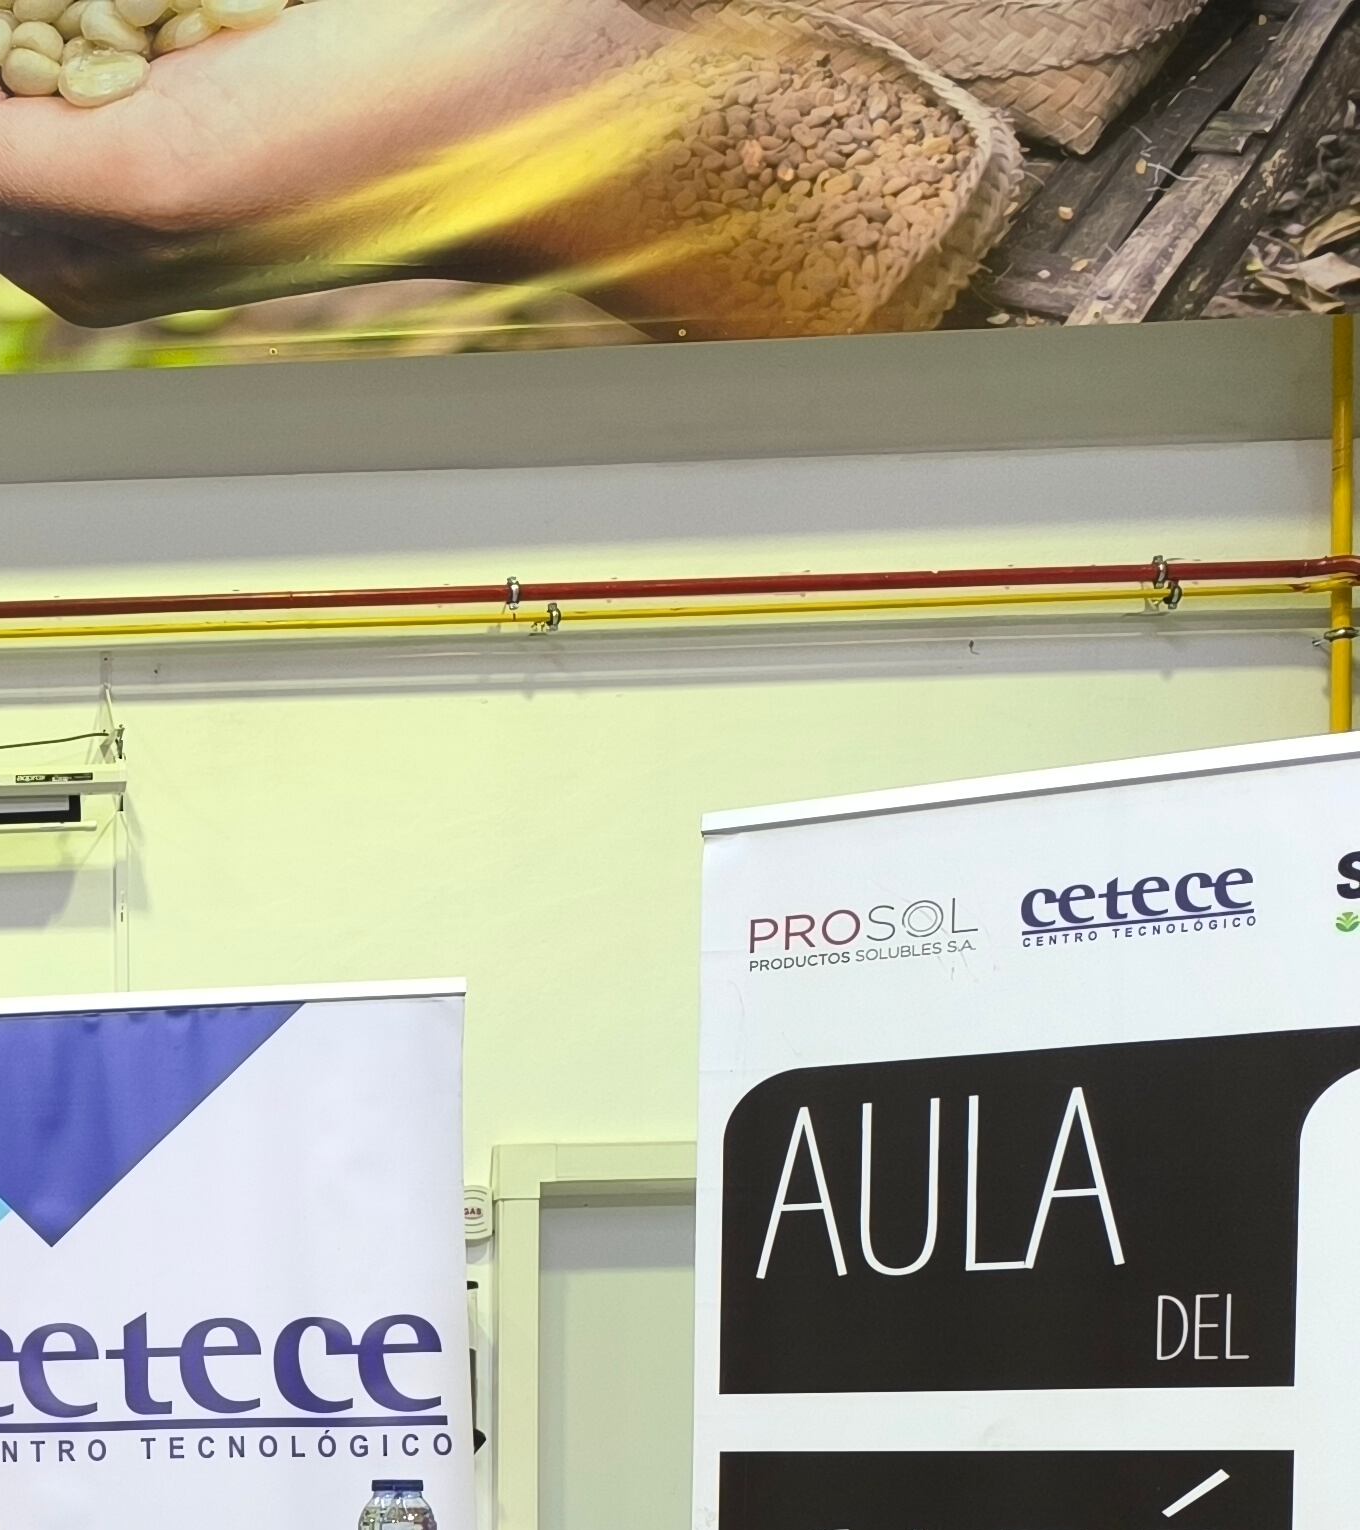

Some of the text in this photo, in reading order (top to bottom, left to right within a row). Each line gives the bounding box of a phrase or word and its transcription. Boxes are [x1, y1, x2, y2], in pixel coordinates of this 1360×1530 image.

[750, 898, 978, 954] PROSOL
[1021, 867, 1254, 929] cetece
[749, 952, 851, 972] PRODUCTOS
[855, 942, 942, 963] SOLUBLES
[1022, 915, 1257, 948] CENTRO TECNOLÓGICO
[756, 1087, 1125, 1280] AULA
[1156, 1293, 1249, 1361] DEL
[140, 1430, 453, 1461] TECNOLÓGICO
